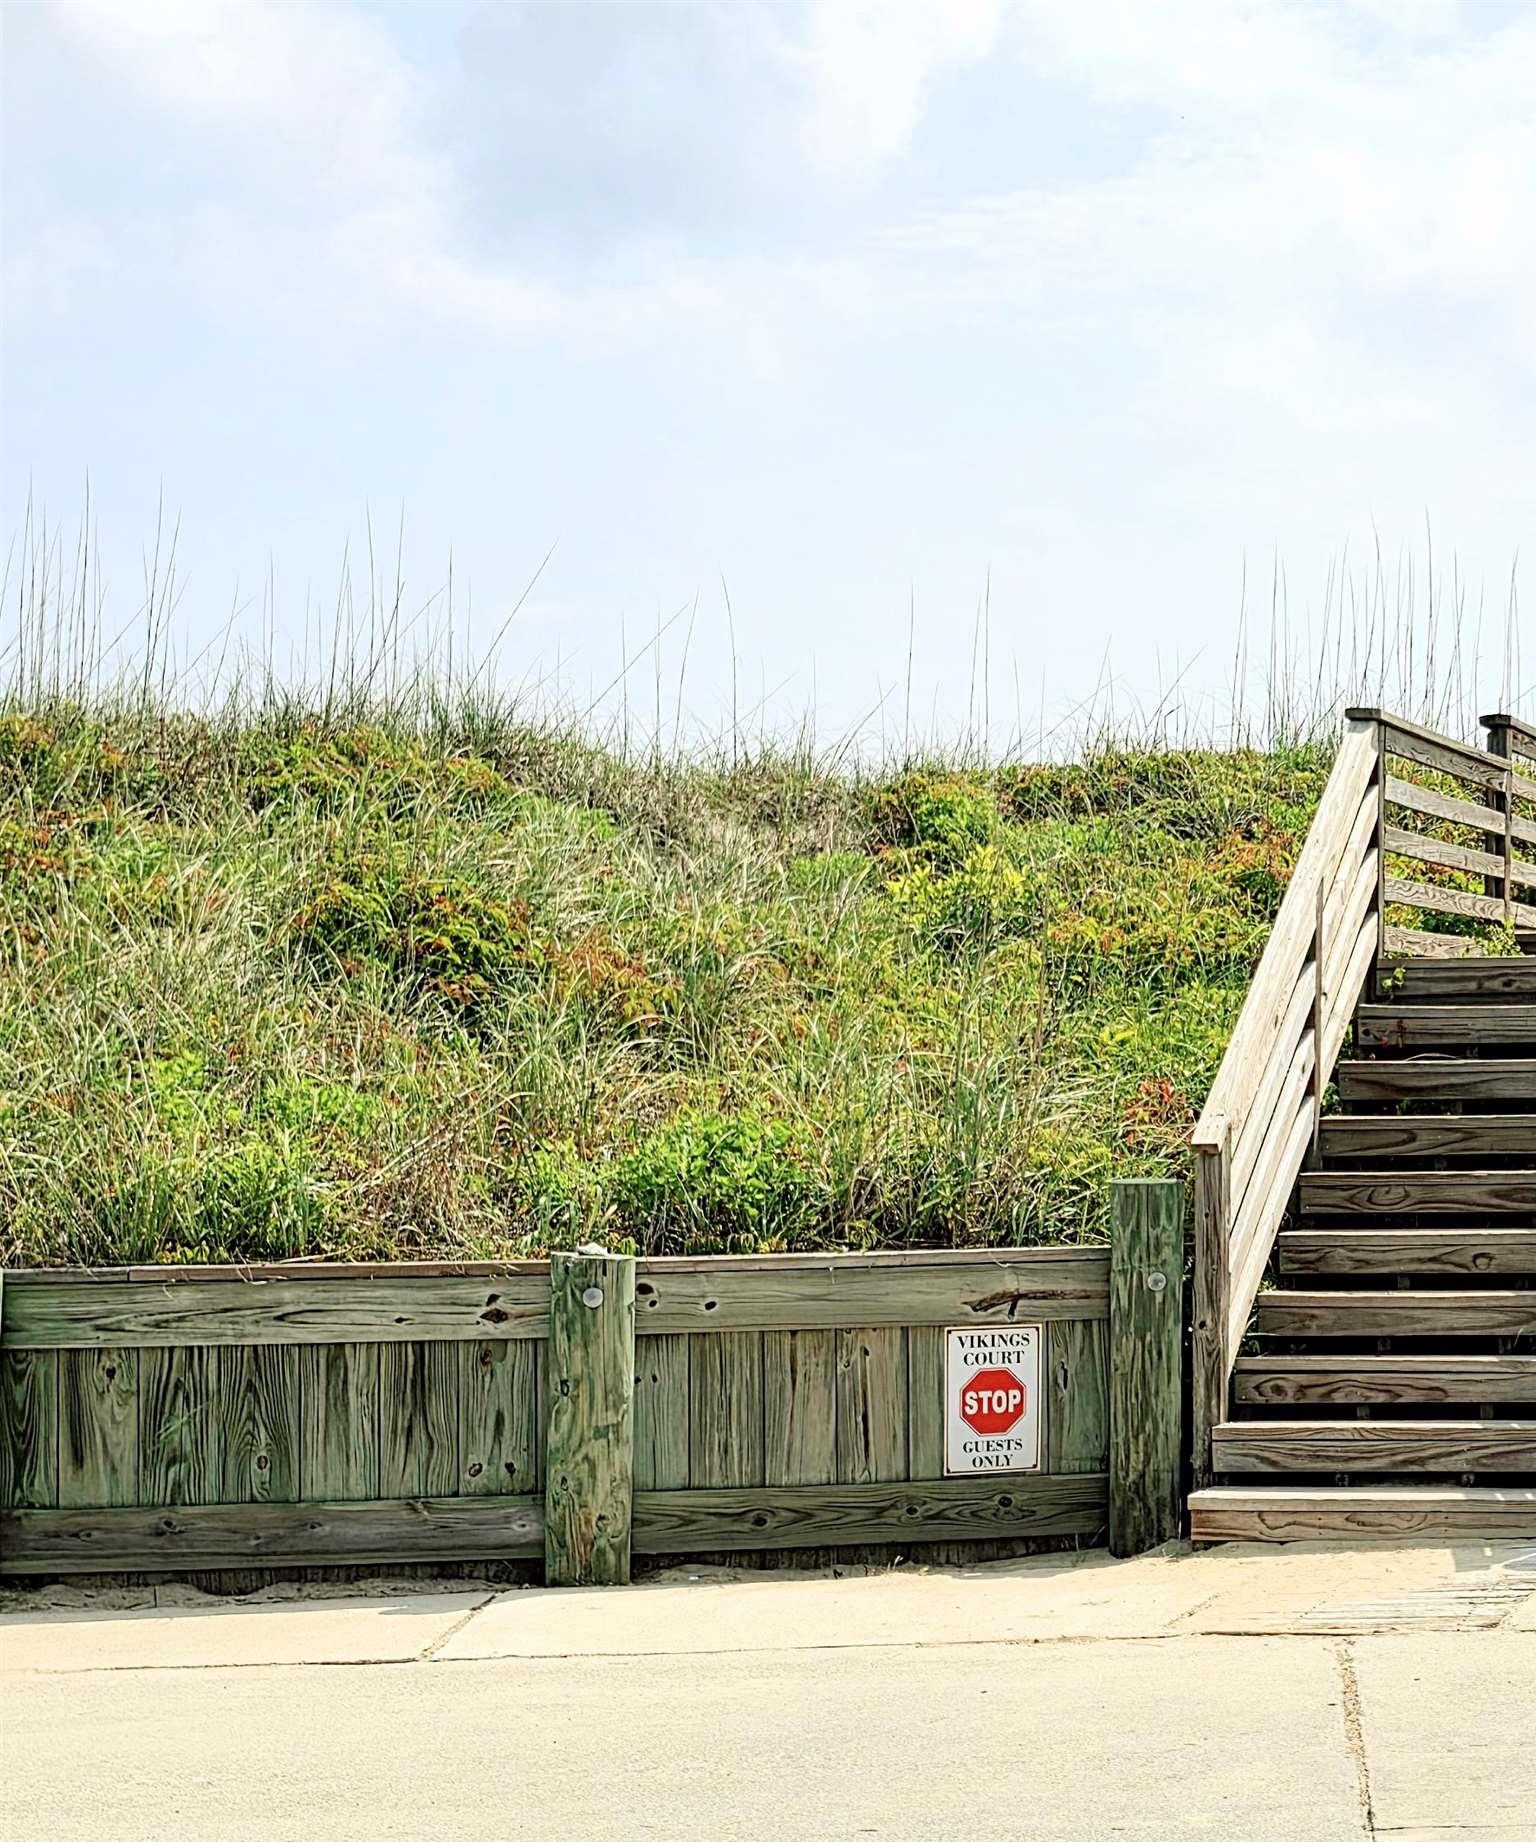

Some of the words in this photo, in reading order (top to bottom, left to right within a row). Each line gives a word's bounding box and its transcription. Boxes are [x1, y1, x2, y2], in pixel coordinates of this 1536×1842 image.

[957, 1333, 1030, 1349] VIKINGS
[963, 1350, 1025, 1366] COURT
[964, 1389, 1021, 1415] STOP
[963, 1438, 1023, 1453] GUESTS
[972, 1454, 1013, 1468] ONLY
